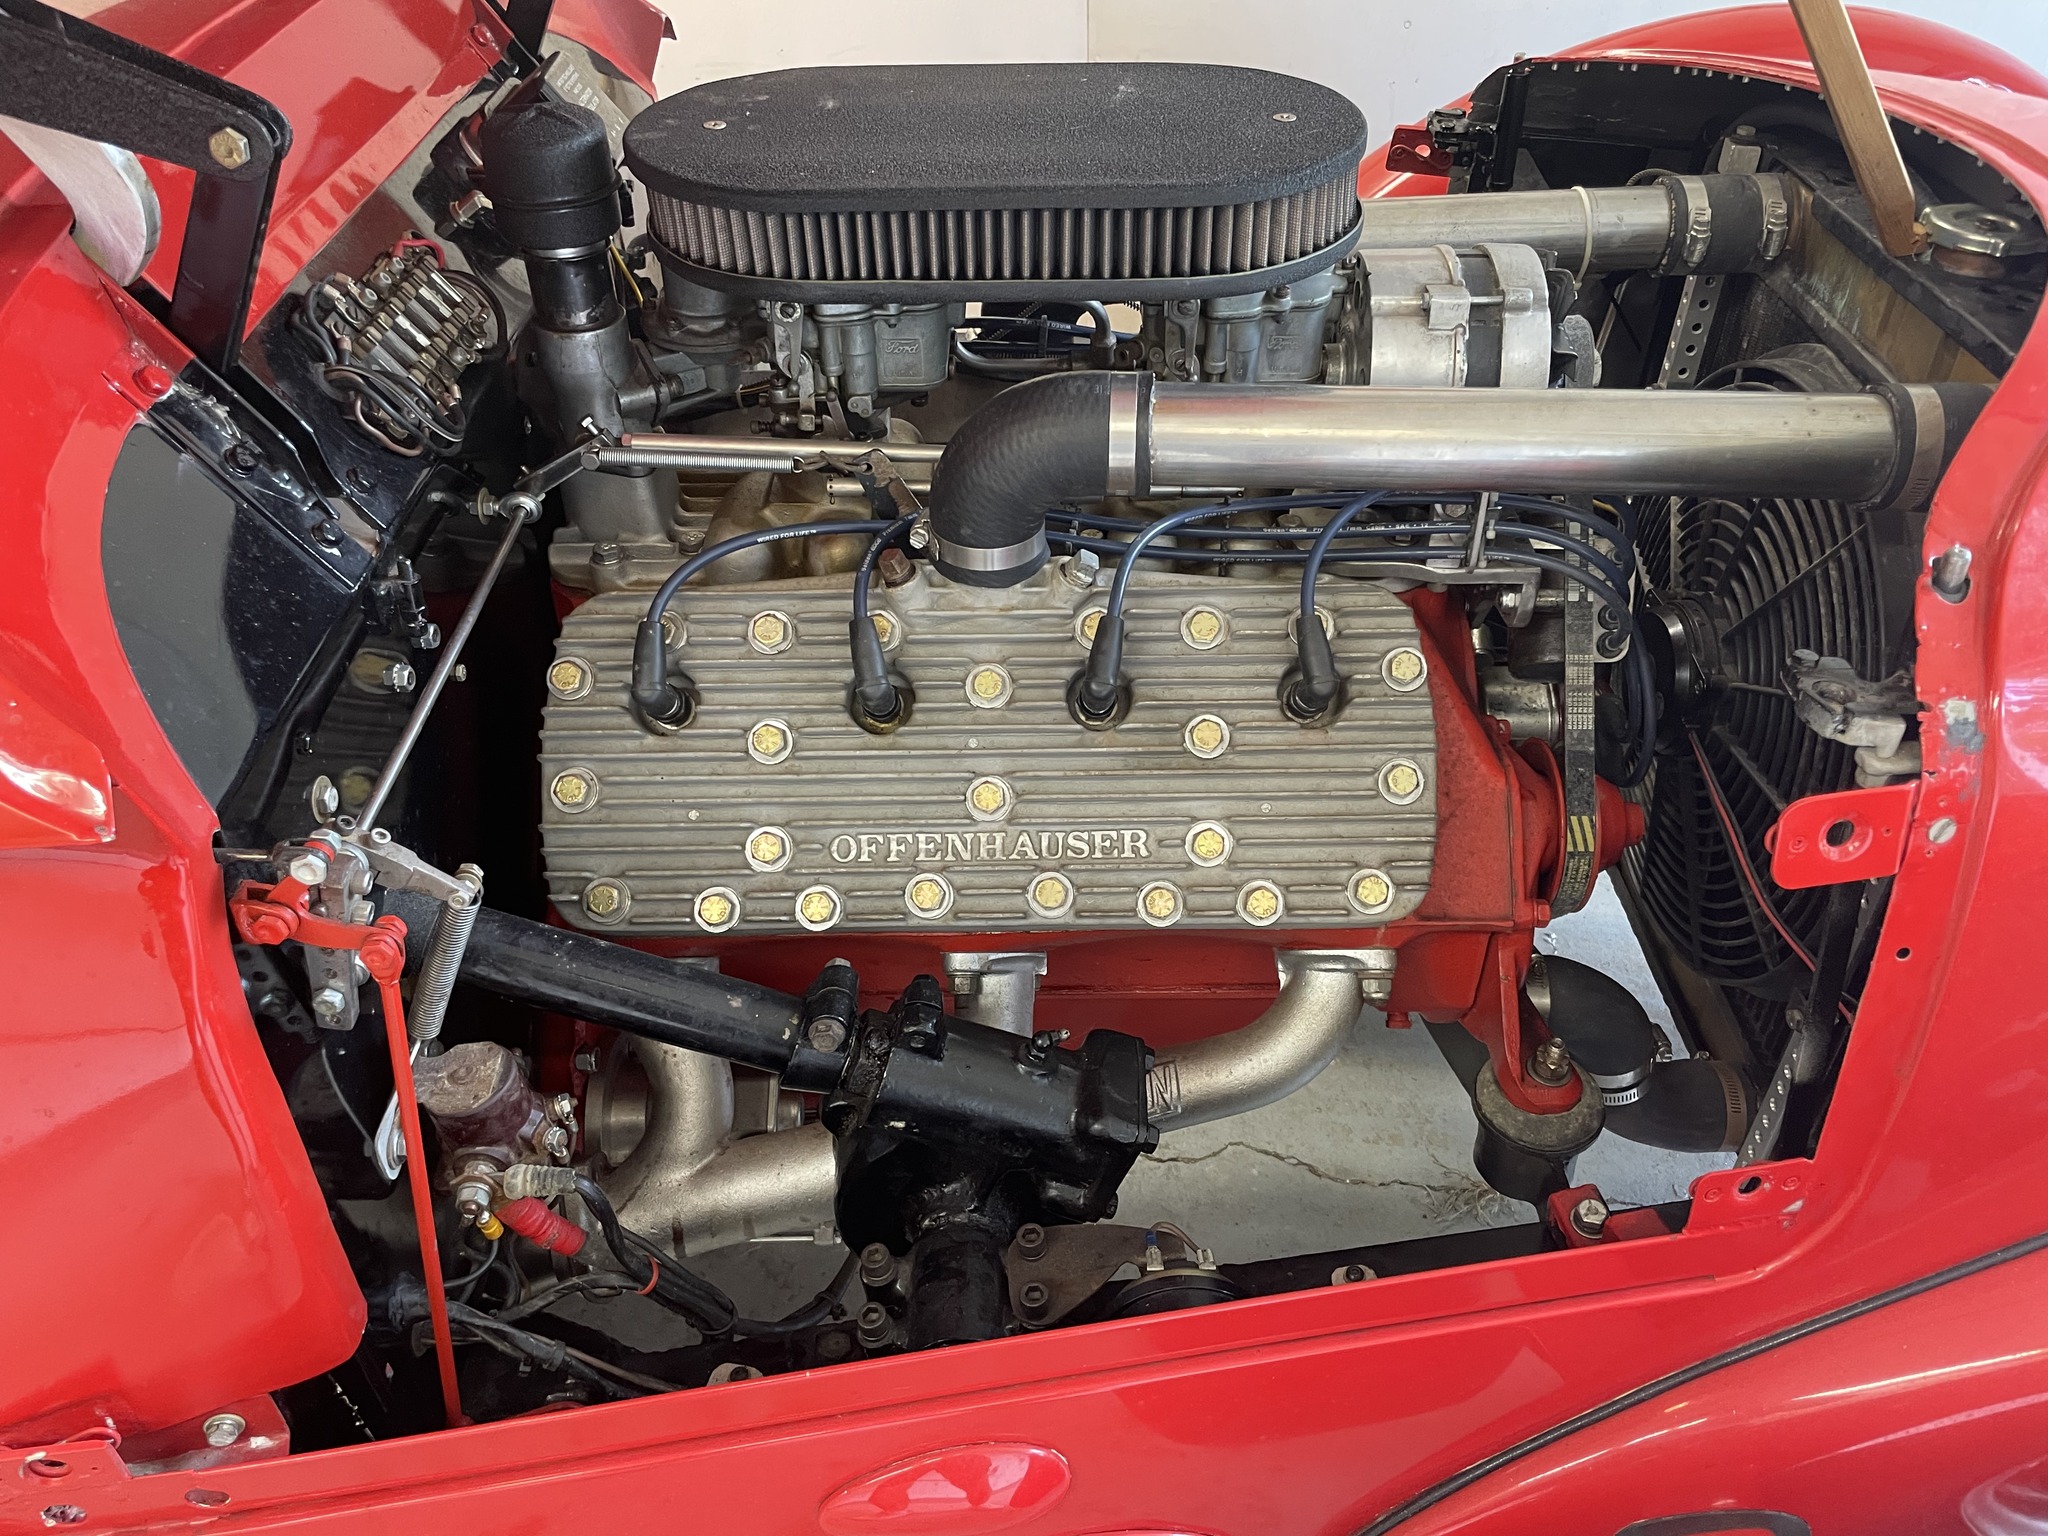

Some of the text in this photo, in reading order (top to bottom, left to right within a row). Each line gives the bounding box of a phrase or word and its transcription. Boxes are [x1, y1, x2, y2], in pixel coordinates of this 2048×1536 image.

[885, 340, 920, 353] Ford
[882, 520, 904, 537] Premium
[756, 534, 779, 543] WIRED
[831, 829, 1150, 863] OFFENHAUSER
